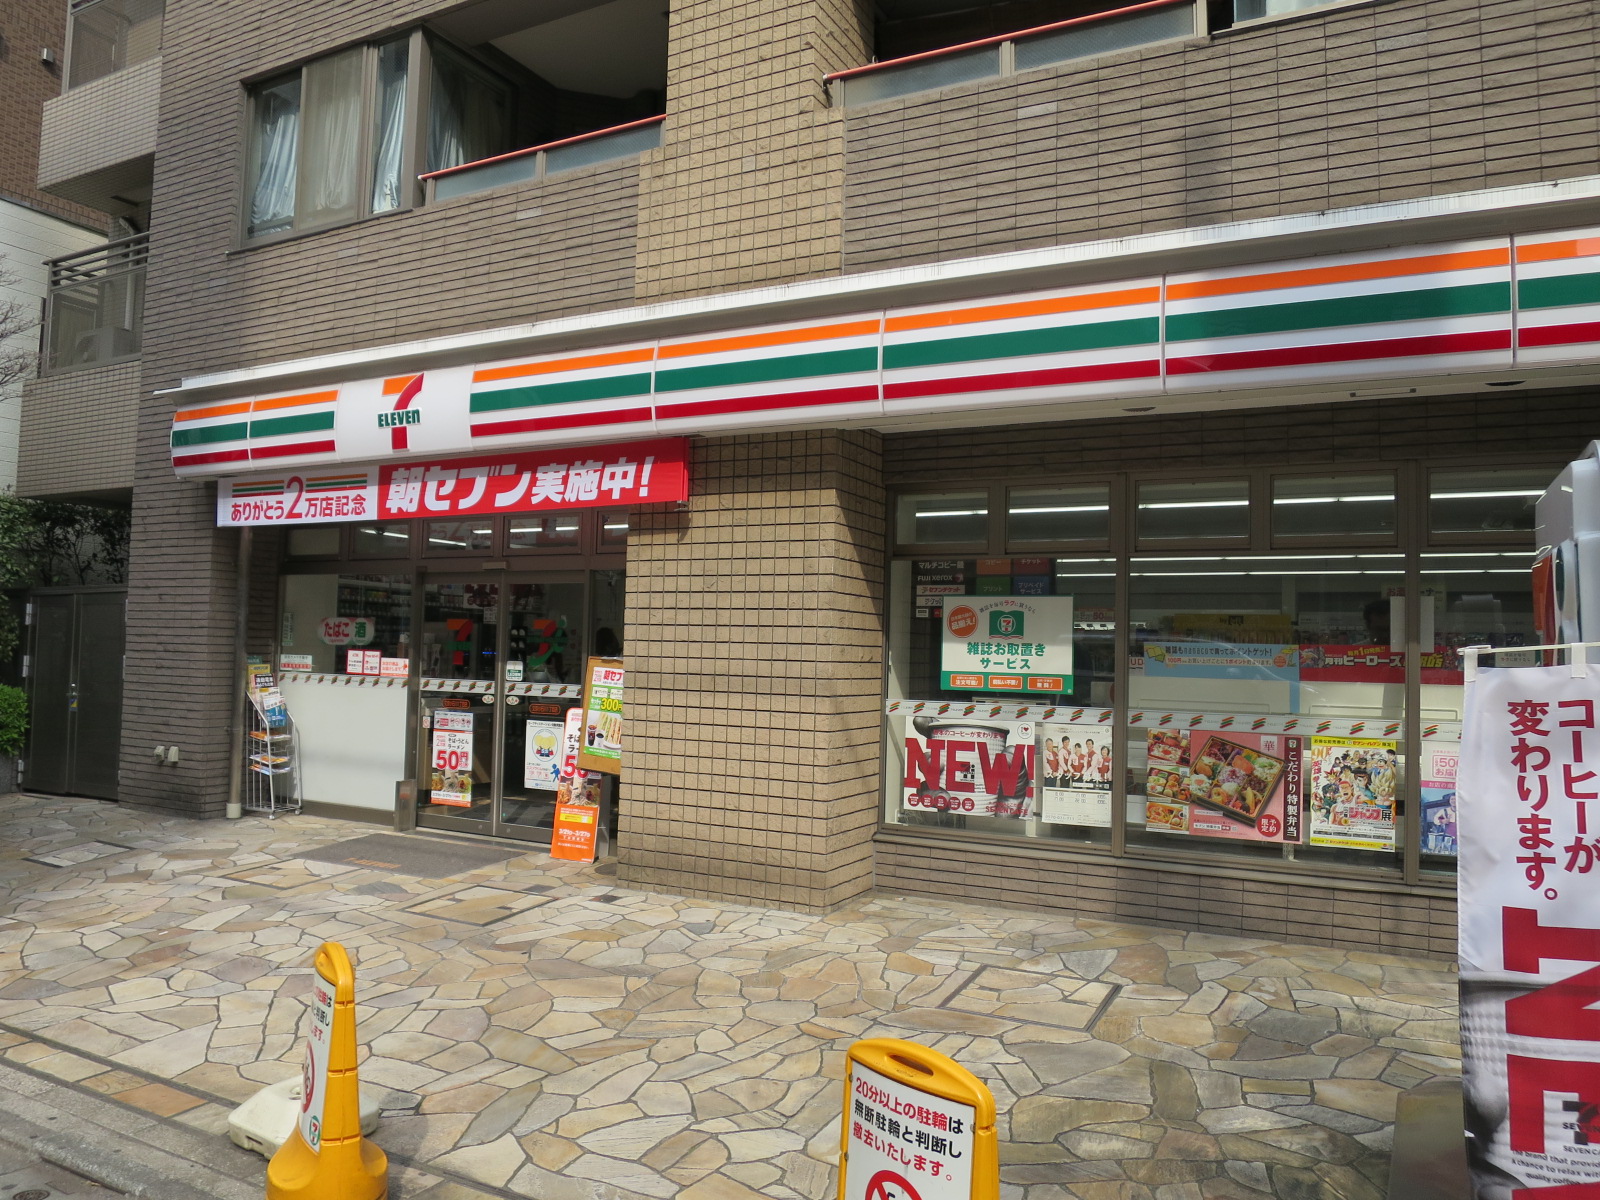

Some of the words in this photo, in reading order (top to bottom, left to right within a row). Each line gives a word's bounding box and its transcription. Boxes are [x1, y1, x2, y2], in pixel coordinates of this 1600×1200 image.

[385, 456, 654, 513] 朝セブン実施中!
[323, 621, 350, 638] たばこ
[354, 621, 367, 638] 酒
[966, 641, 1046, 657] 雑誌お取置き
[979, 657, 1031, 670] サービス
[904, 737, 1035, 798] NEW!
[1286, 751, 1299, 837] こだわり特製弁当
[1435, 768, 1457, 777] お届
[1558, 699, 1600, 874] コーヒーが
[1507, 699, 1558, 901] 変わります。
[853, 1098, 963, 1159] 無断駐輪と判断し
[855, 1076, 964, 1135] 20分以上の駐輪は
[852, 1119, 953, 1182] 撤去いたします。
[1525, 1152, 1547, 1162] brand
[1549, 1155, 1569, 1165] that
[1546, 1166, 1556, 1175] to
[1557, 1168, 1581, 1179] relax
